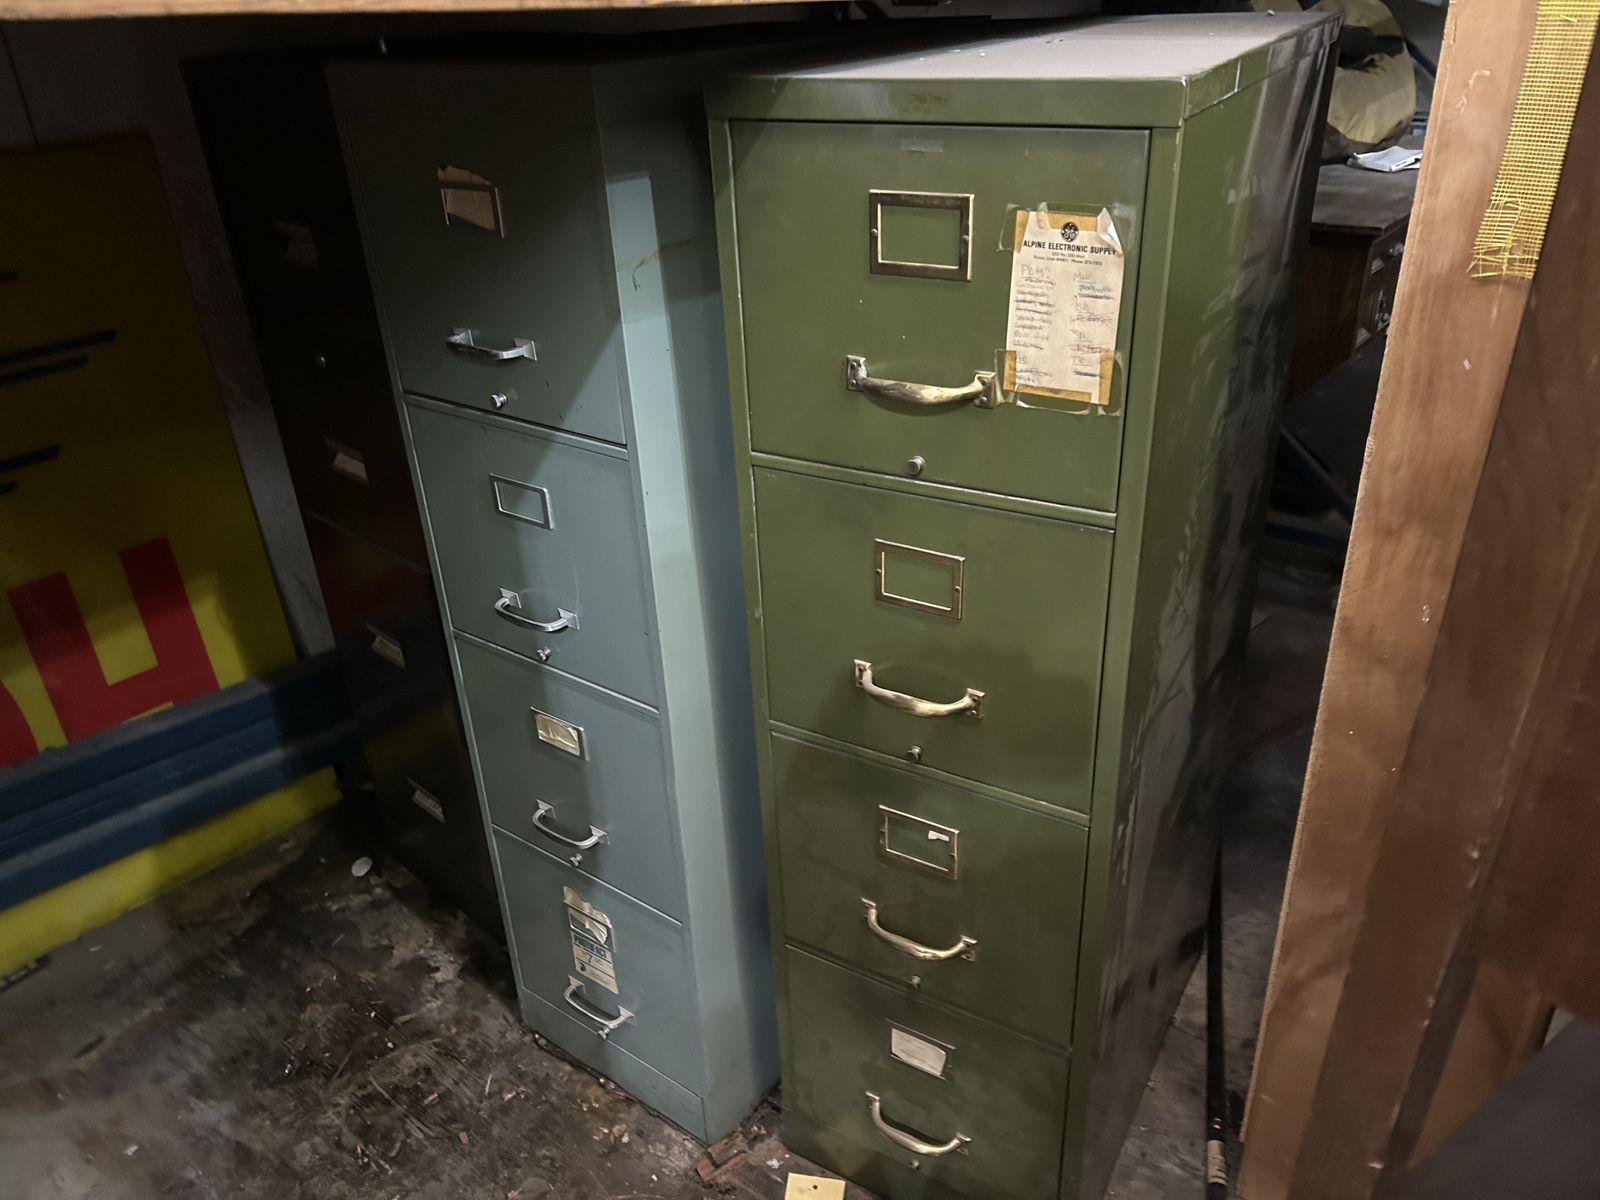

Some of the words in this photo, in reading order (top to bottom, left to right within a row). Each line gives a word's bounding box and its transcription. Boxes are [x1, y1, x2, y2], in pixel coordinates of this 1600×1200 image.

[1023, 240, 1046, 249] ALPINE
[1048, 242, 1088, 252] ELECTRONIC
[1090, 246, 1116, 256] SUPPLY
